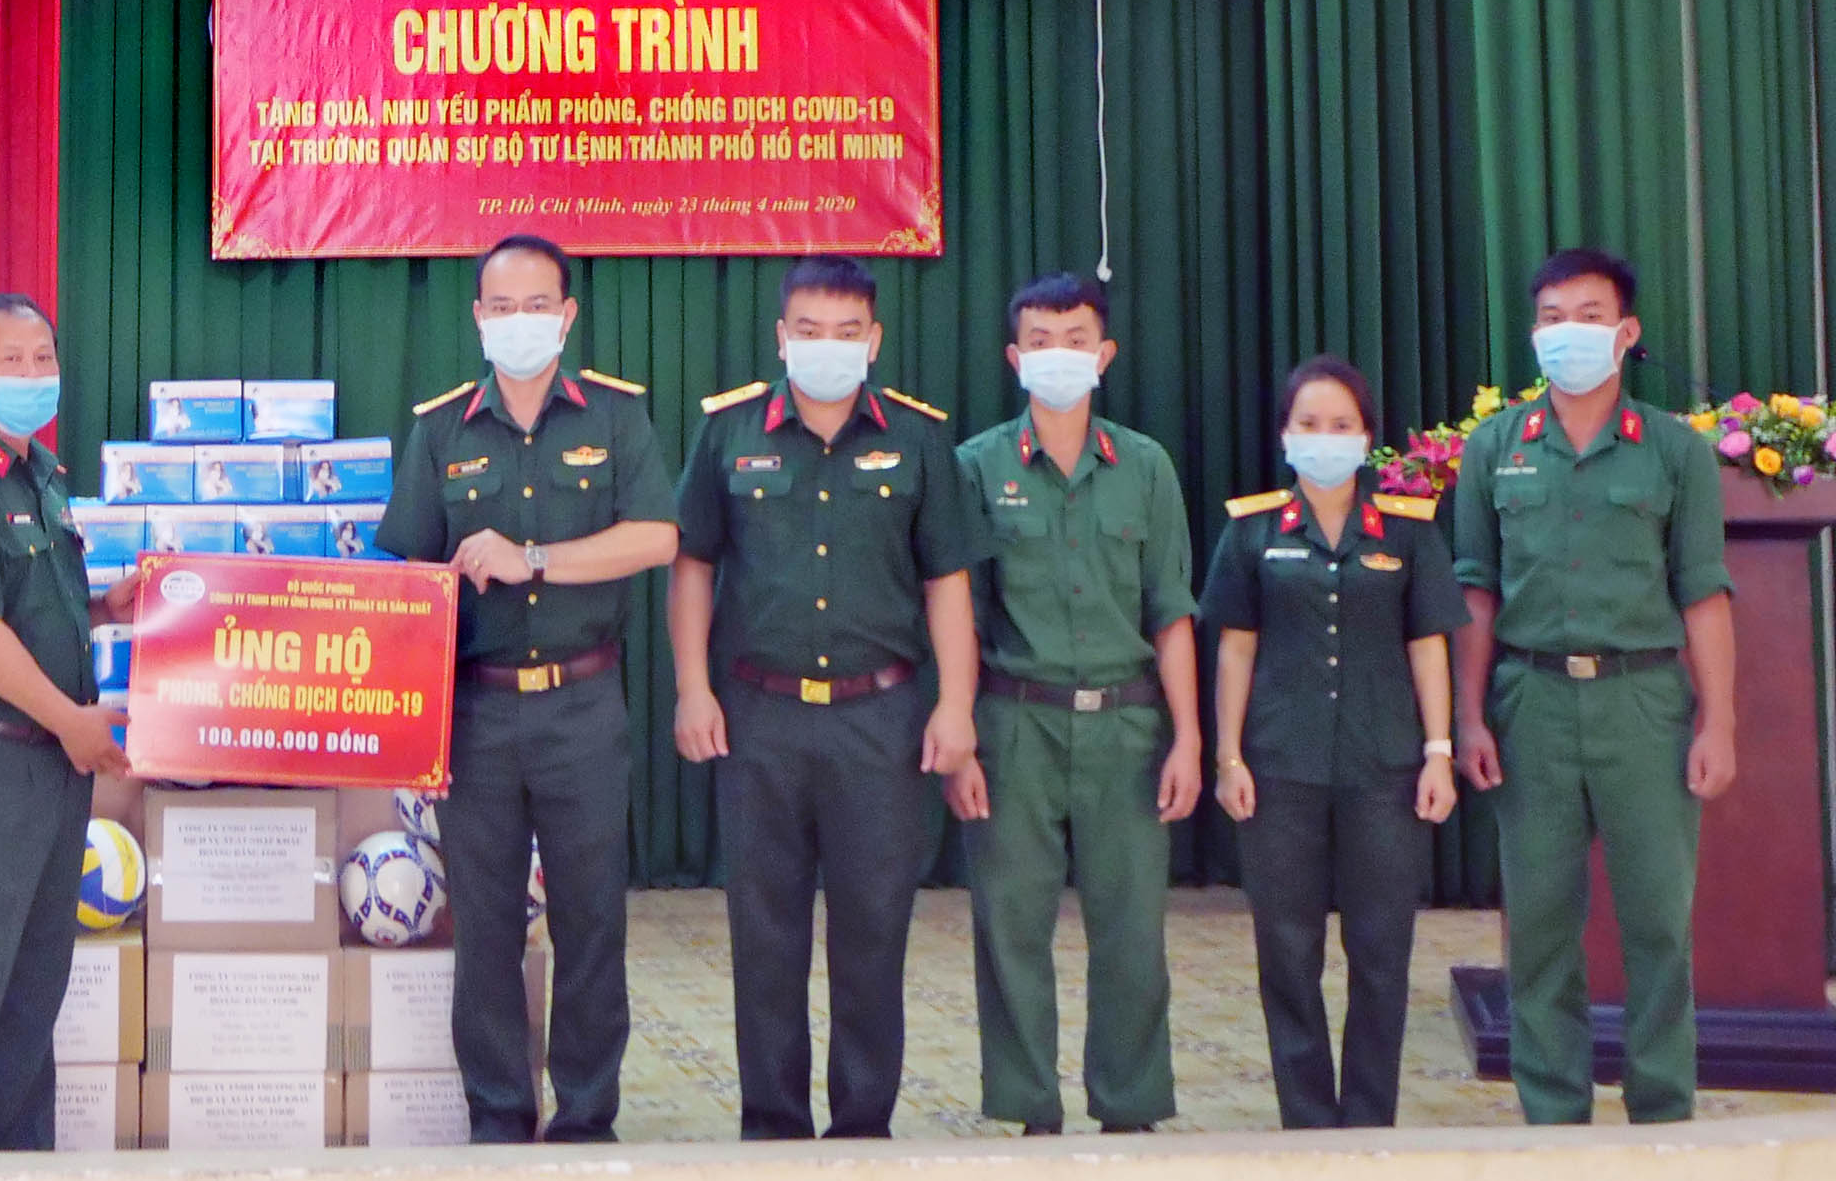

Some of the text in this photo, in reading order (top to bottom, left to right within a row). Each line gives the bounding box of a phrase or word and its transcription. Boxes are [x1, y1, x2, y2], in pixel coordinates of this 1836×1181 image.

[393, 2, 597, 74] CHƯƠNG
[256, 88, 894, 131] TẶNG QUÀ, NHU YẾU PHẨM PHÒNG, CHỐNG DỊCH COVID-19
[249, 139, 283, 169] TẠI
[289, 133, 380, 165] TRƯỜNG
[386, 133, 449, 165] QUÂN
[455, 134, 489, 168] SỰ
[493, 131, 523, 168] BỘ
[529, 133, 560, 162] TƯ
[565, 131, 622, 167] LỆNH
[628, 130, 702, 162] THÀNH
[798, 129, 836, 161] CHÍ
[843, 134, 904, 160] MINH
[508, 194, 535, 214] Hồ
[540, 197, 572, 214] Chí
[575, 196, 626, 214] Minh,
[632, 196, 673, 216] ngày
[702, 196, 751, 216] tháng
[756, 196, 768, 211] 4
[772, 196, 809, 212] năm
[815, 195, 856, 212] 2020
[214, 614, 372, 684] ỦNG HỘ
[229, 675, 290, 711] CHỐNG
[295, 685, 337, 716] DỊCH
[342, 687, 424, 717] COVID-19
[197, 726, 319, 752] 100.000.000
